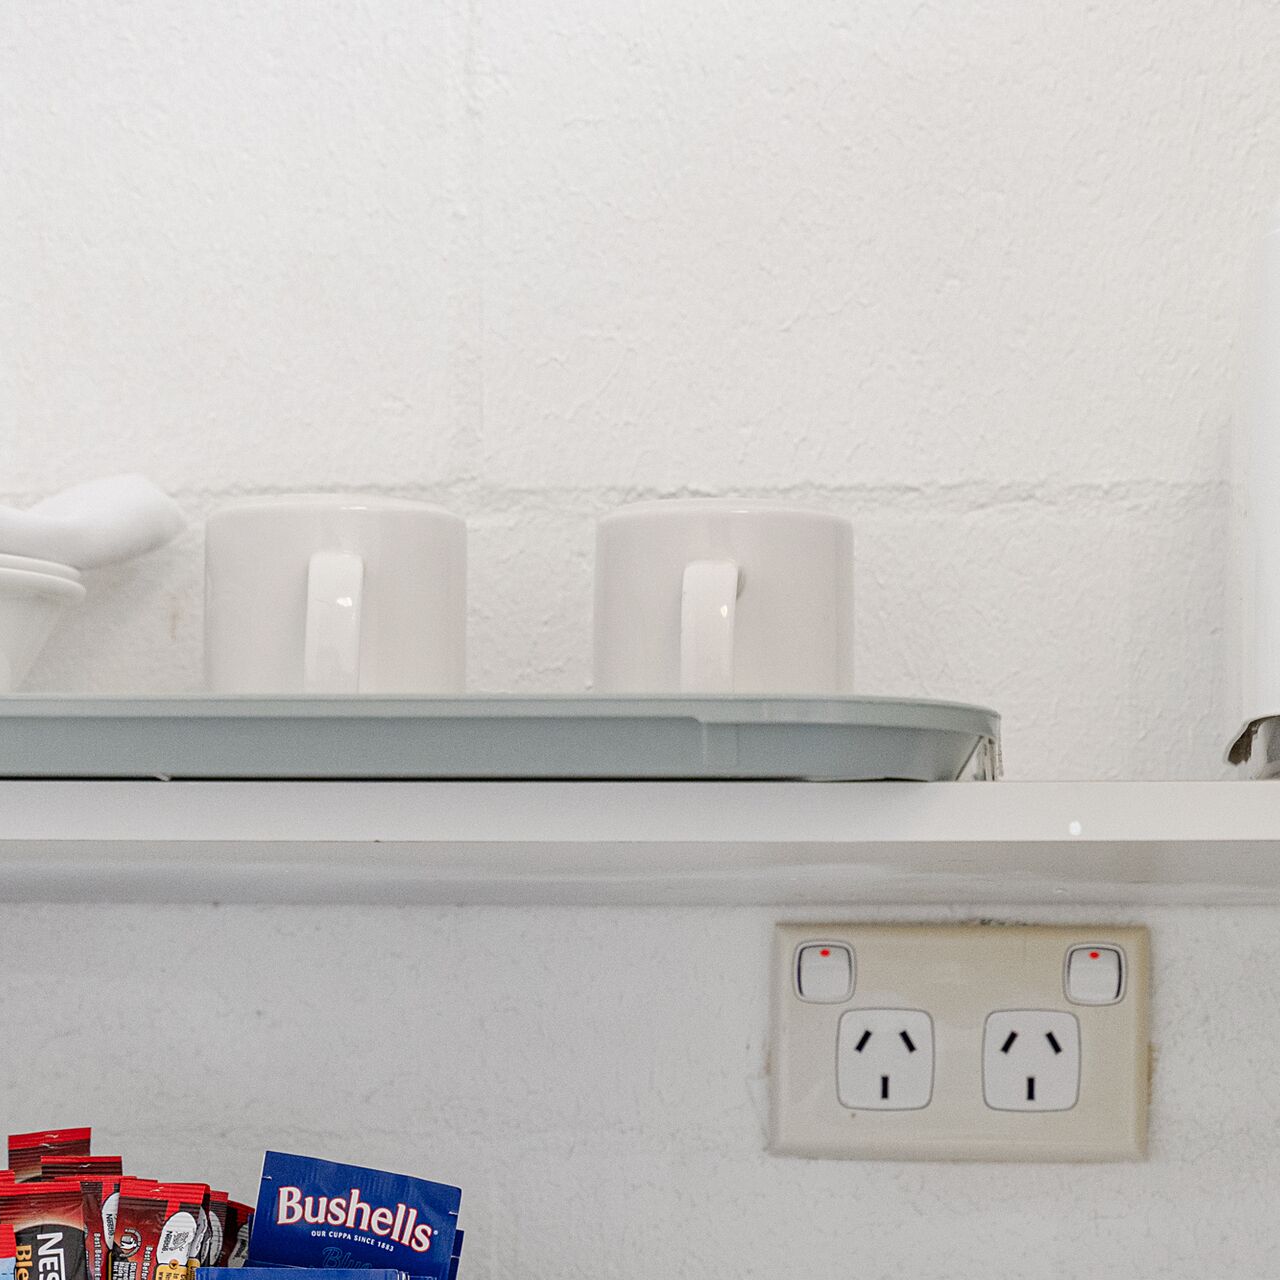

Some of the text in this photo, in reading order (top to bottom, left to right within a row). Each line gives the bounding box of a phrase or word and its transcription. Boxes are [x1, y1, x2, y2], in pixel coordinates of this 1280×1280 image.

[276, 1186, 432, 1253] Bushells
[311, 1230, 326, 1238] OUR
[329, 1231, 352, 1240] CUPPA
[354, 1234, 375, 1245] SINCE
[144, 1246, 153, 1261] Best
